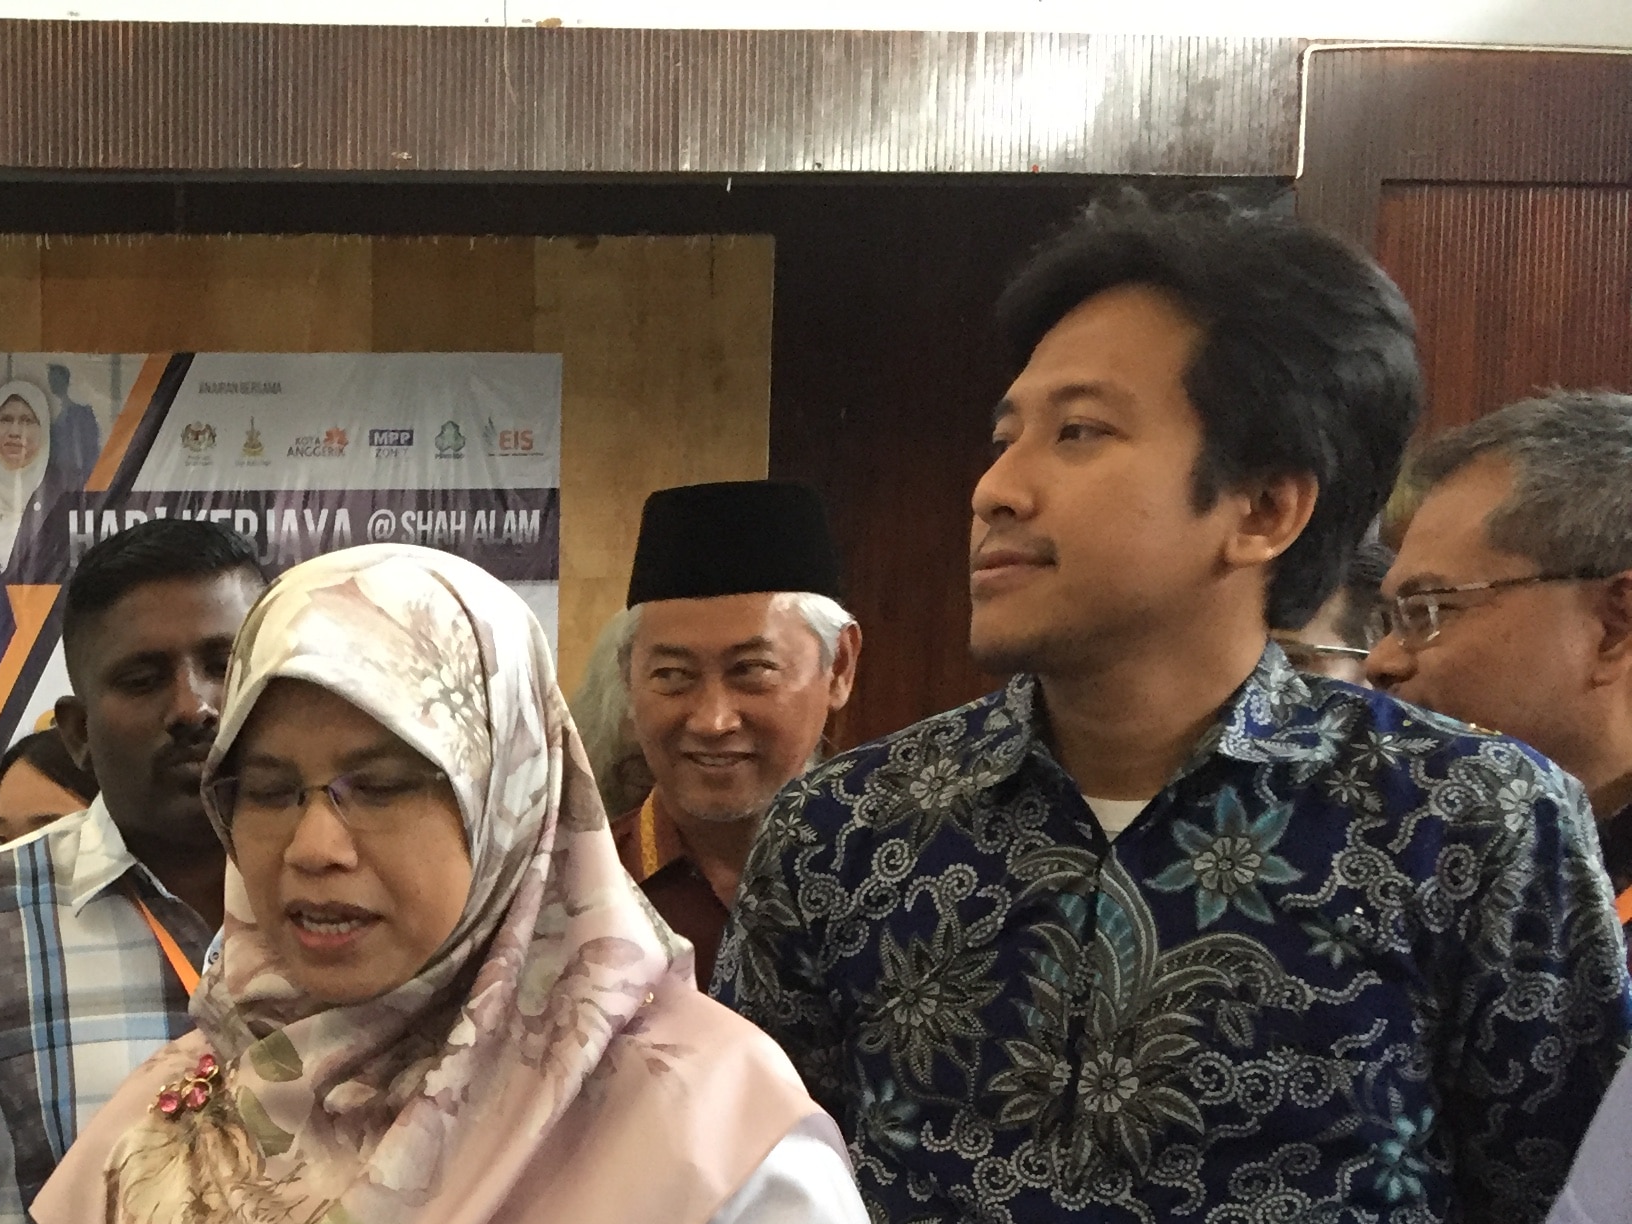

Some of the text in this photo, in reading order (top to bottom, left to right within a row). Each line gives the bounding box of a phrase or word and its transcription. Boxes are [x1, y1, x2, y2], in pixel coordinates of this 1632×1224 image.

[373, 431, 411, 446] MPP
[498, 429, 534, 451] EIS
[471, 509, 541, 545] ALAM
